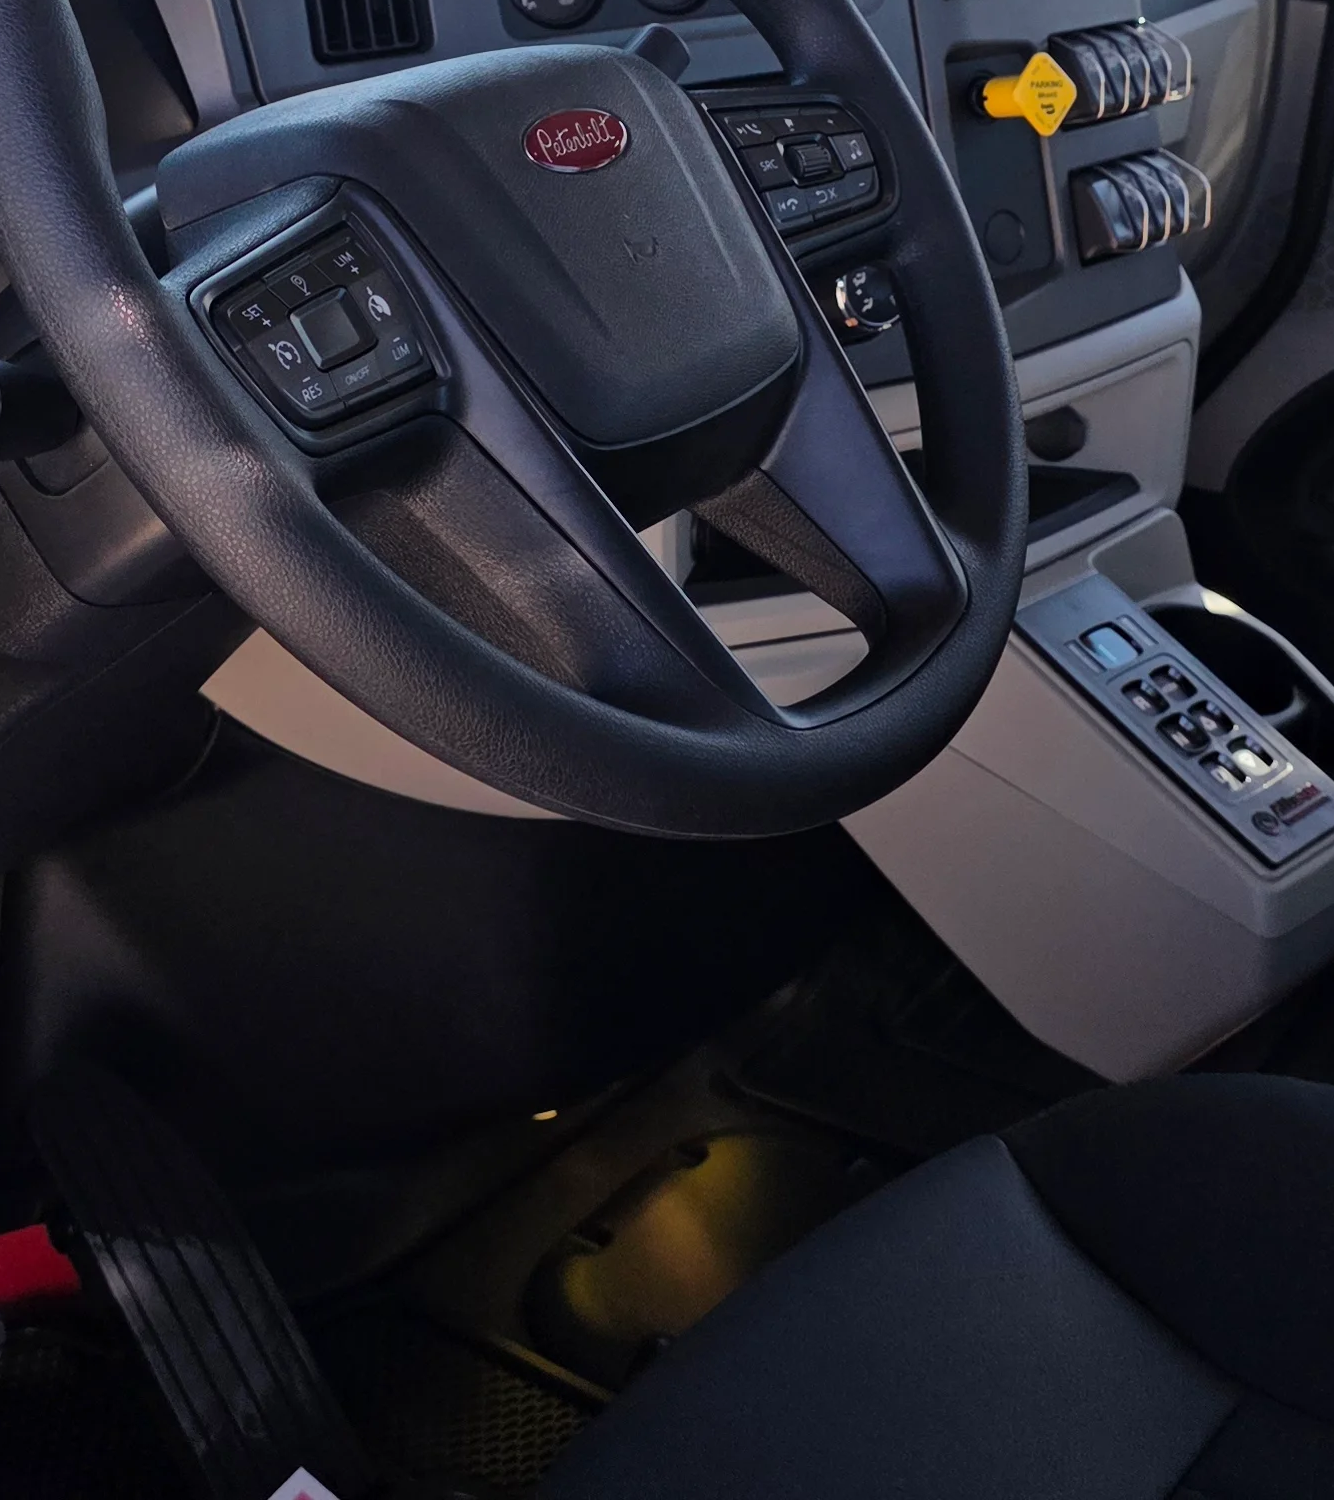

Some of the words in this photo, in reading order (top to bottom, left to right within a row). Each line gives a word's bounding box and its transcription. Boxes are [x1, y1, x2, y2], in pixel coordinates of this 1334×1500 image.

[1029, 80, 1064, 88] PARKING
[537, 115, 616, 163] Peterbilt
[759, 158, 779, 172] SRC
[332, 251, 355, 268] LIM
[241, 303, 264, 321] SET
[390, 343, 411, 361] LIM
[344, 365, 370, 386] ON/OFF
[301, 382, 323, 403] RES
